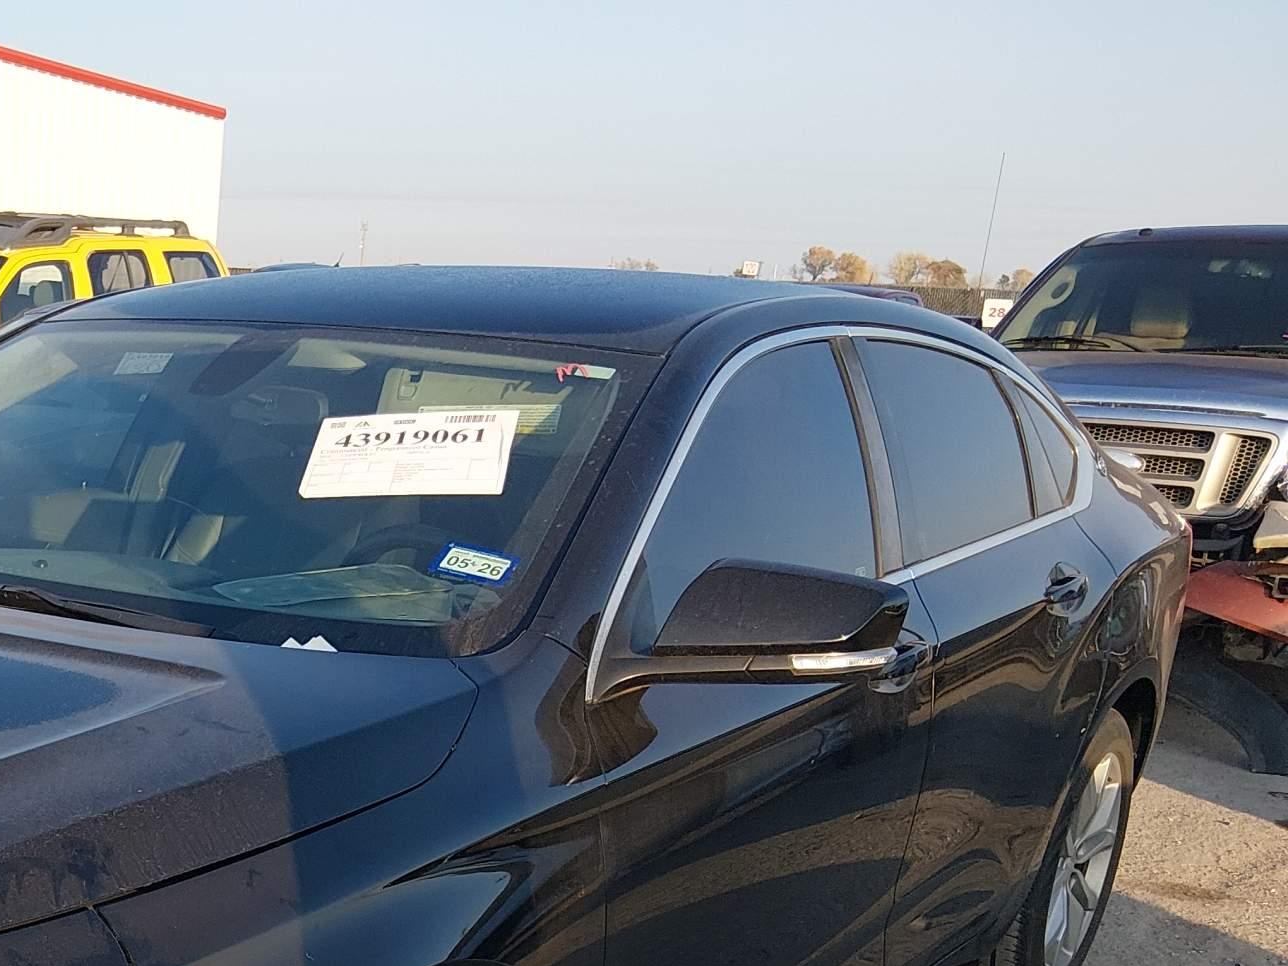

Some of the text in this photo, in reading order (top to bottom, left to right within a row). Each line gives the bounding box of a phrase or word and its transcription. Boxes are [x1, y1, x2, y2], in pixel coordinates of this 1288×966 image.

[988, 307, 1006, 318] 28
[335, 428, 486, 448] 43919061
[446, 555, 472, 569] 05
[476, 562, 504, 577] 26
